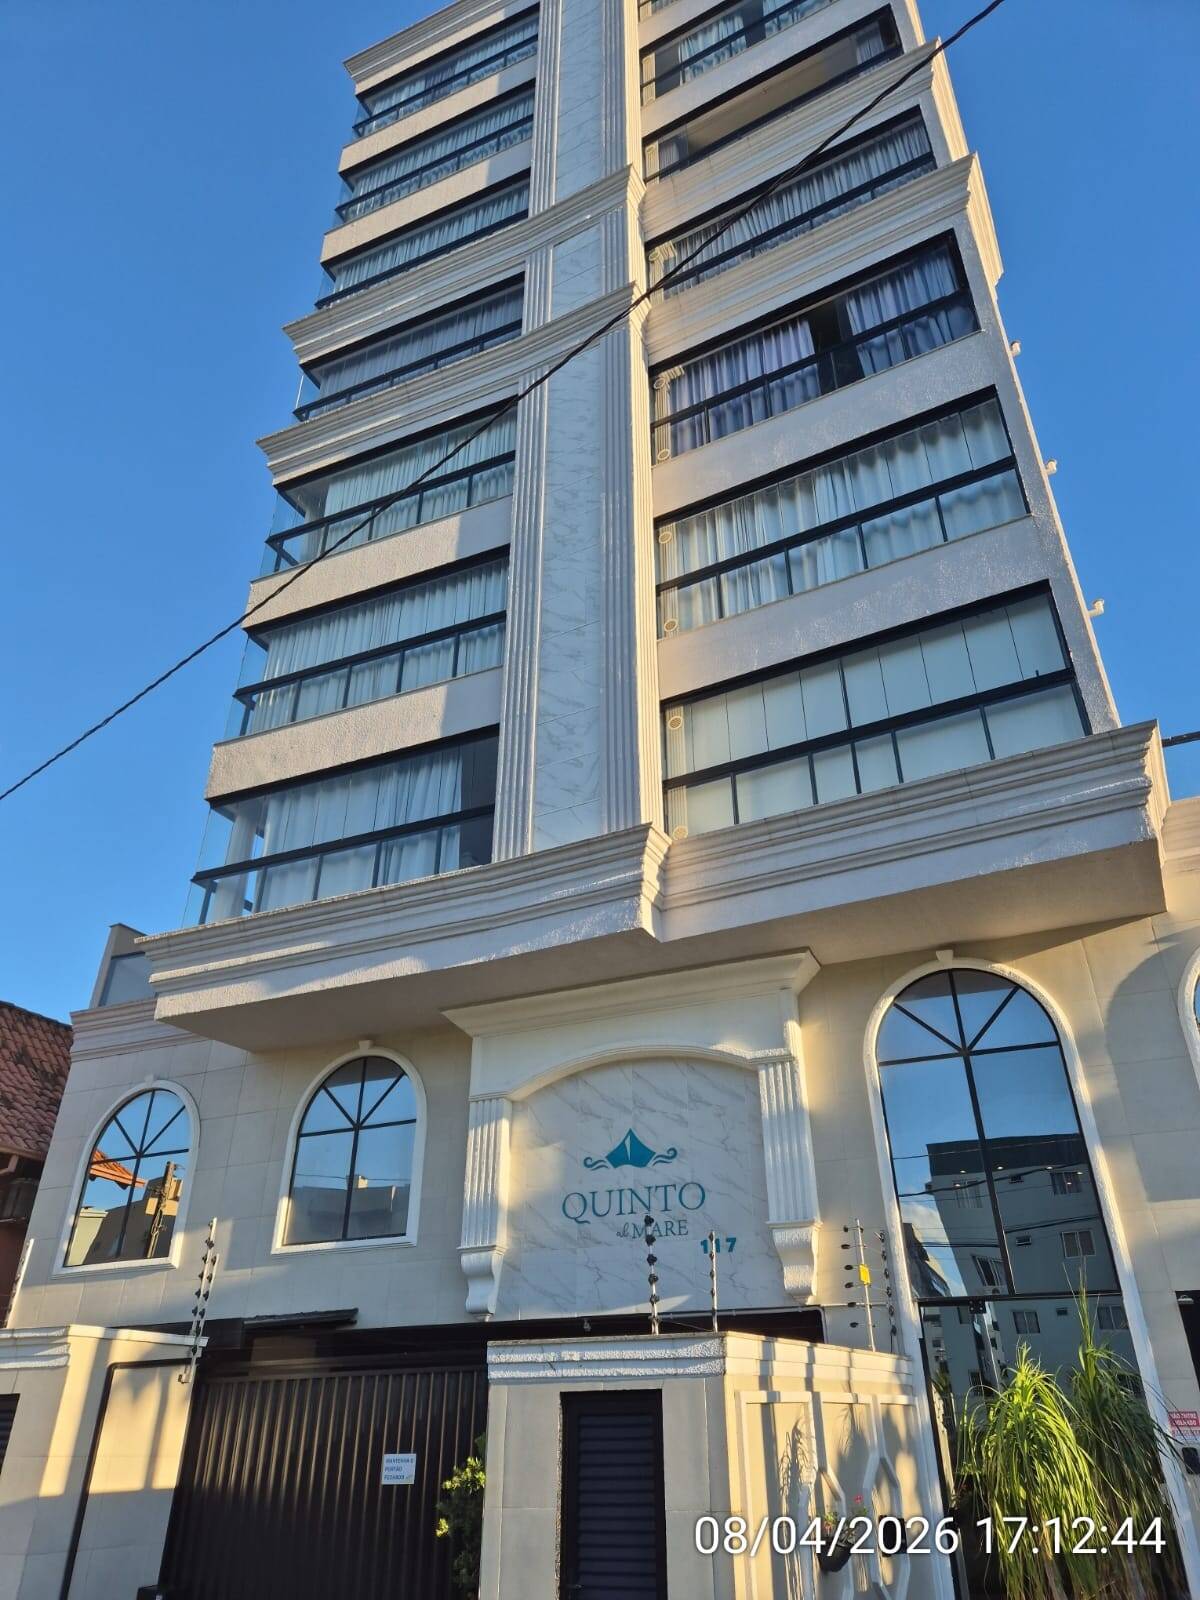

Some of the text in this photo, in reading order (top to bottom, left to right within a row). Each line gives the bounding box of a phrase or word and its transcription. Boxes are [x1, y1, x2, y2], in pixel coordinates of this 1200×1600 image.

[562, 1182, 706, 1224] QUINTO
[632, 1219, 689, 1239] MARE
[701, 1237, 737, 1255] 117
